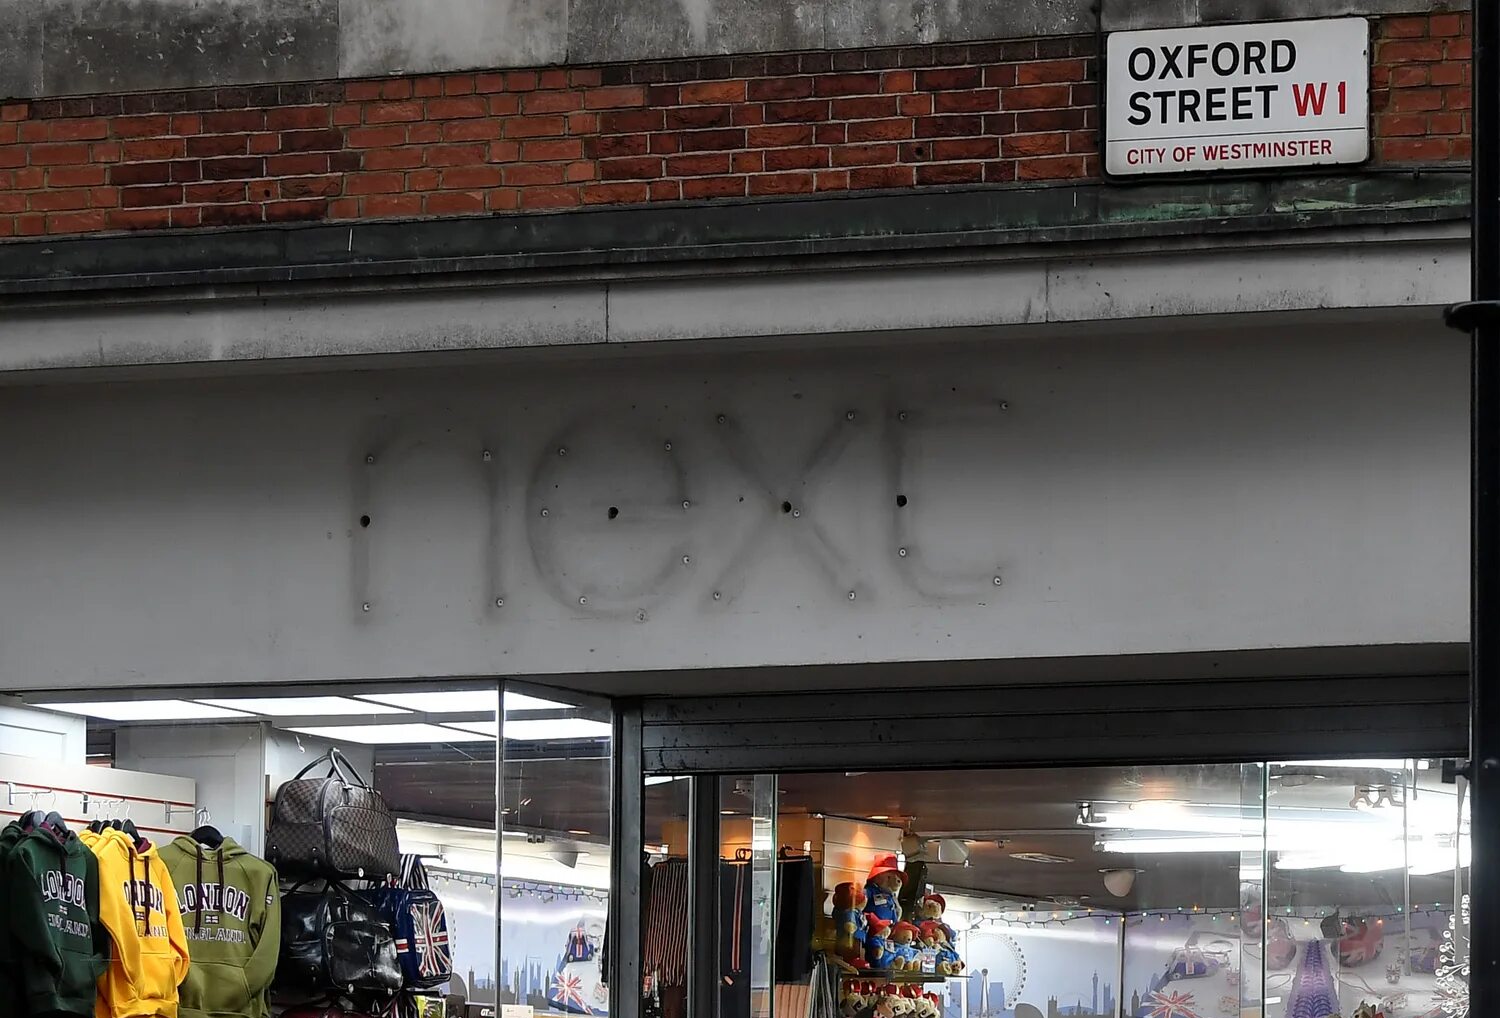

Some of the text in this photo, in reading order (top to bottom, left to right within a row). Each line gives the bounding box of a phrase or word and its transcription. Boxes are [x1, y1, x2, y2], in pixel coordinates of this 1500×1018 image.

[1128, 39, 1296, 81] OXFORD
[1127, 81, 1346, 125] STREET W1
[1127, 139, 1332, 165] CITY OF WESTMINSTER
[348, 405, 1010, 628] next
[41, 870, 86, 911] LONDO
